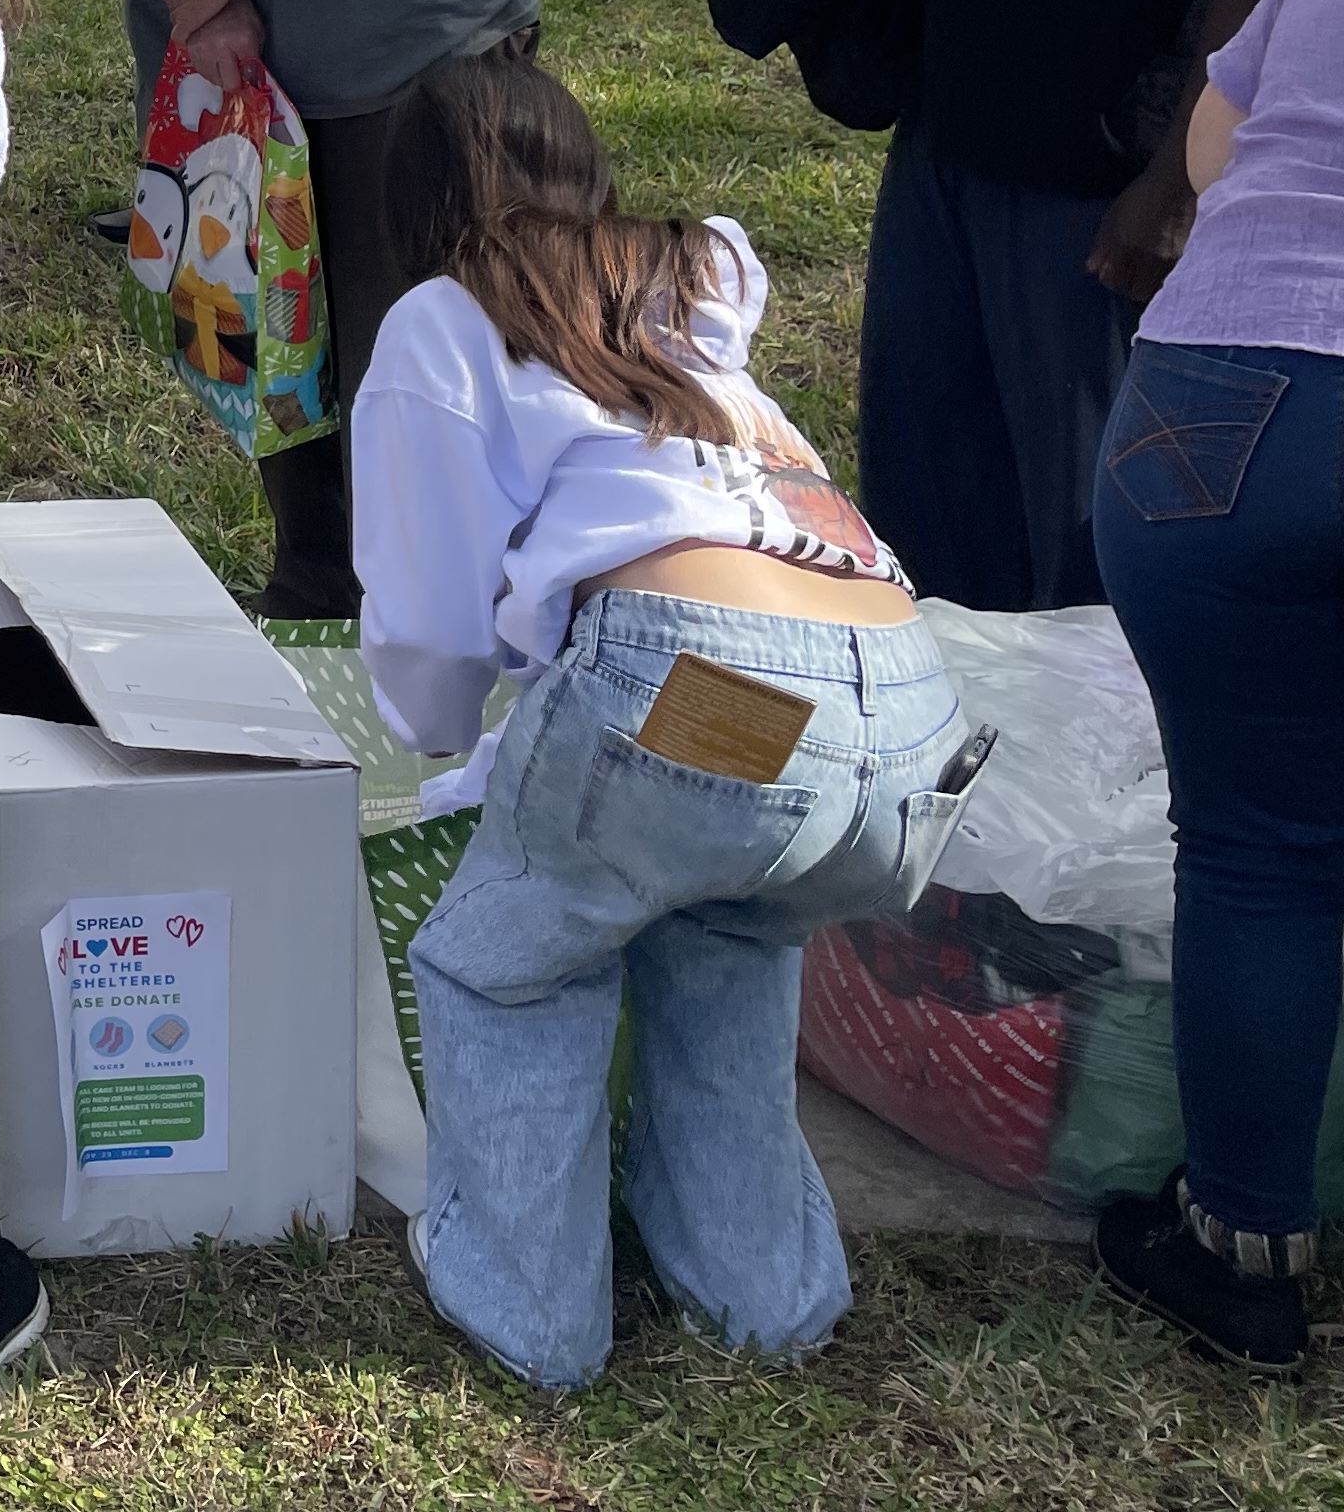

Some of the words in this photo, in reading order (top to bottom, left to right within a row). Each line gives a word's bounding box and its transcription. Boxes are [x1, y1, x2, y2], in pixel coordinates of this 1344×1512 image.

[76, 916, 144, 932] SPREAD
[78, 962, 101, 975] TO
[109, 961, 143, 973] THE
[72, 974, 176, 990] SHELTERED
[111, 993, 182, 1007] DONATE
